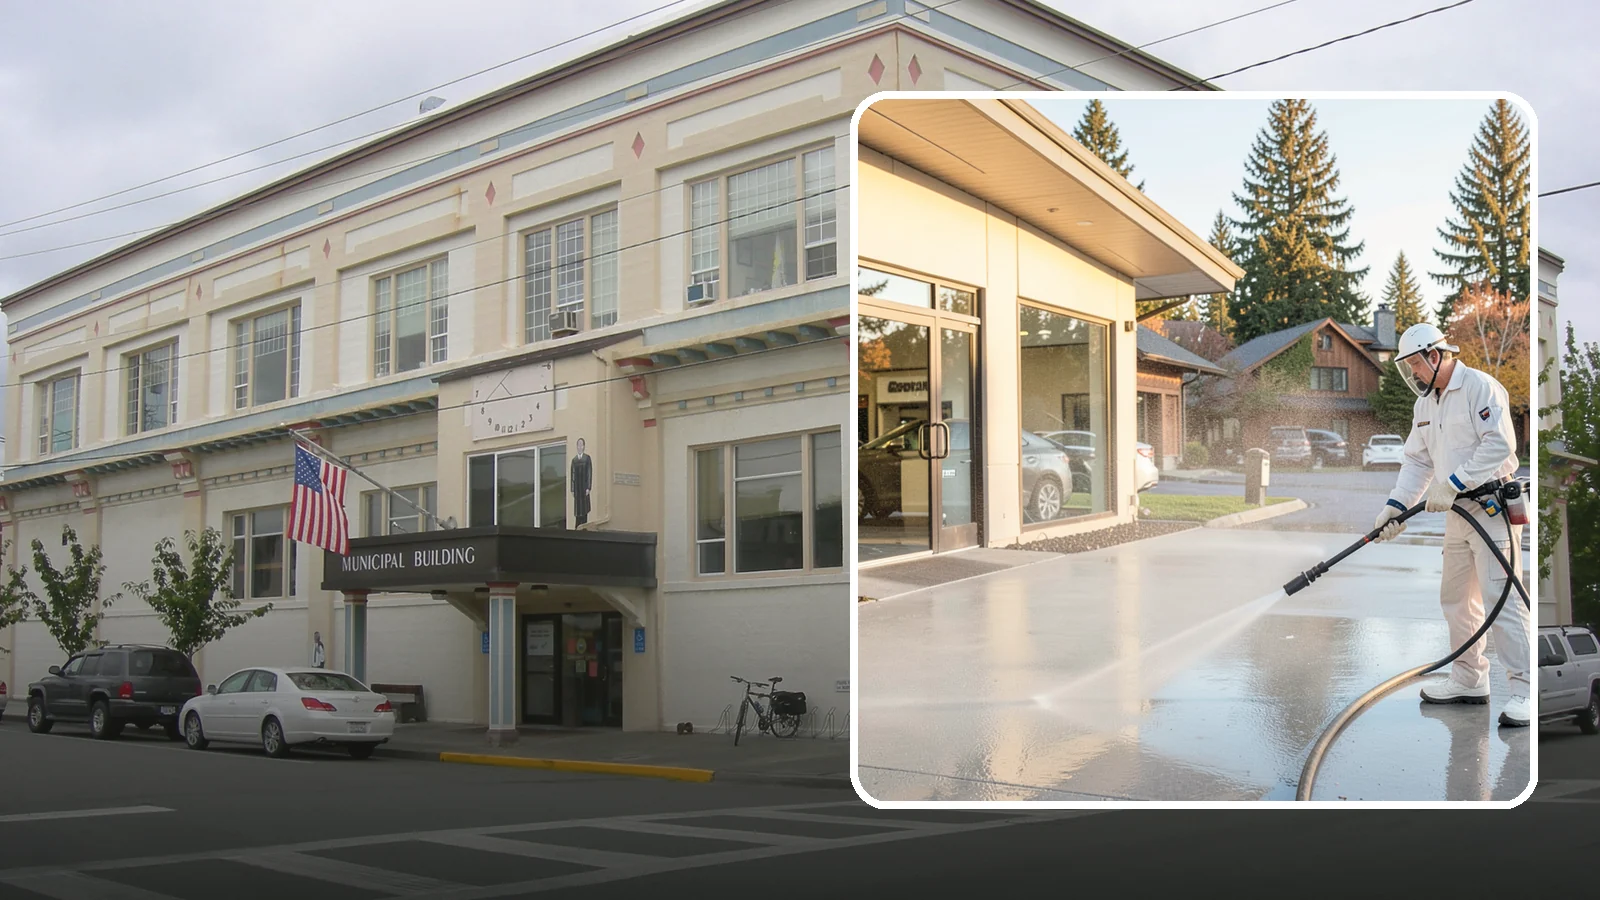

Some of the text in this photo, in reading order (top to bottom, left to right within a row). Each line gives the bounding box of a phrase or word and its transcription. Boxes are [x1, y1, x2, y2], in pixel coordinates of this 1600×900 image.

[487, 417, 493, 426] 9
[494, 423, 500, 432] 10
[507, 425, 513, 433] 12
[342, 546, 475, 572] MUNICIPAL BUILDING
